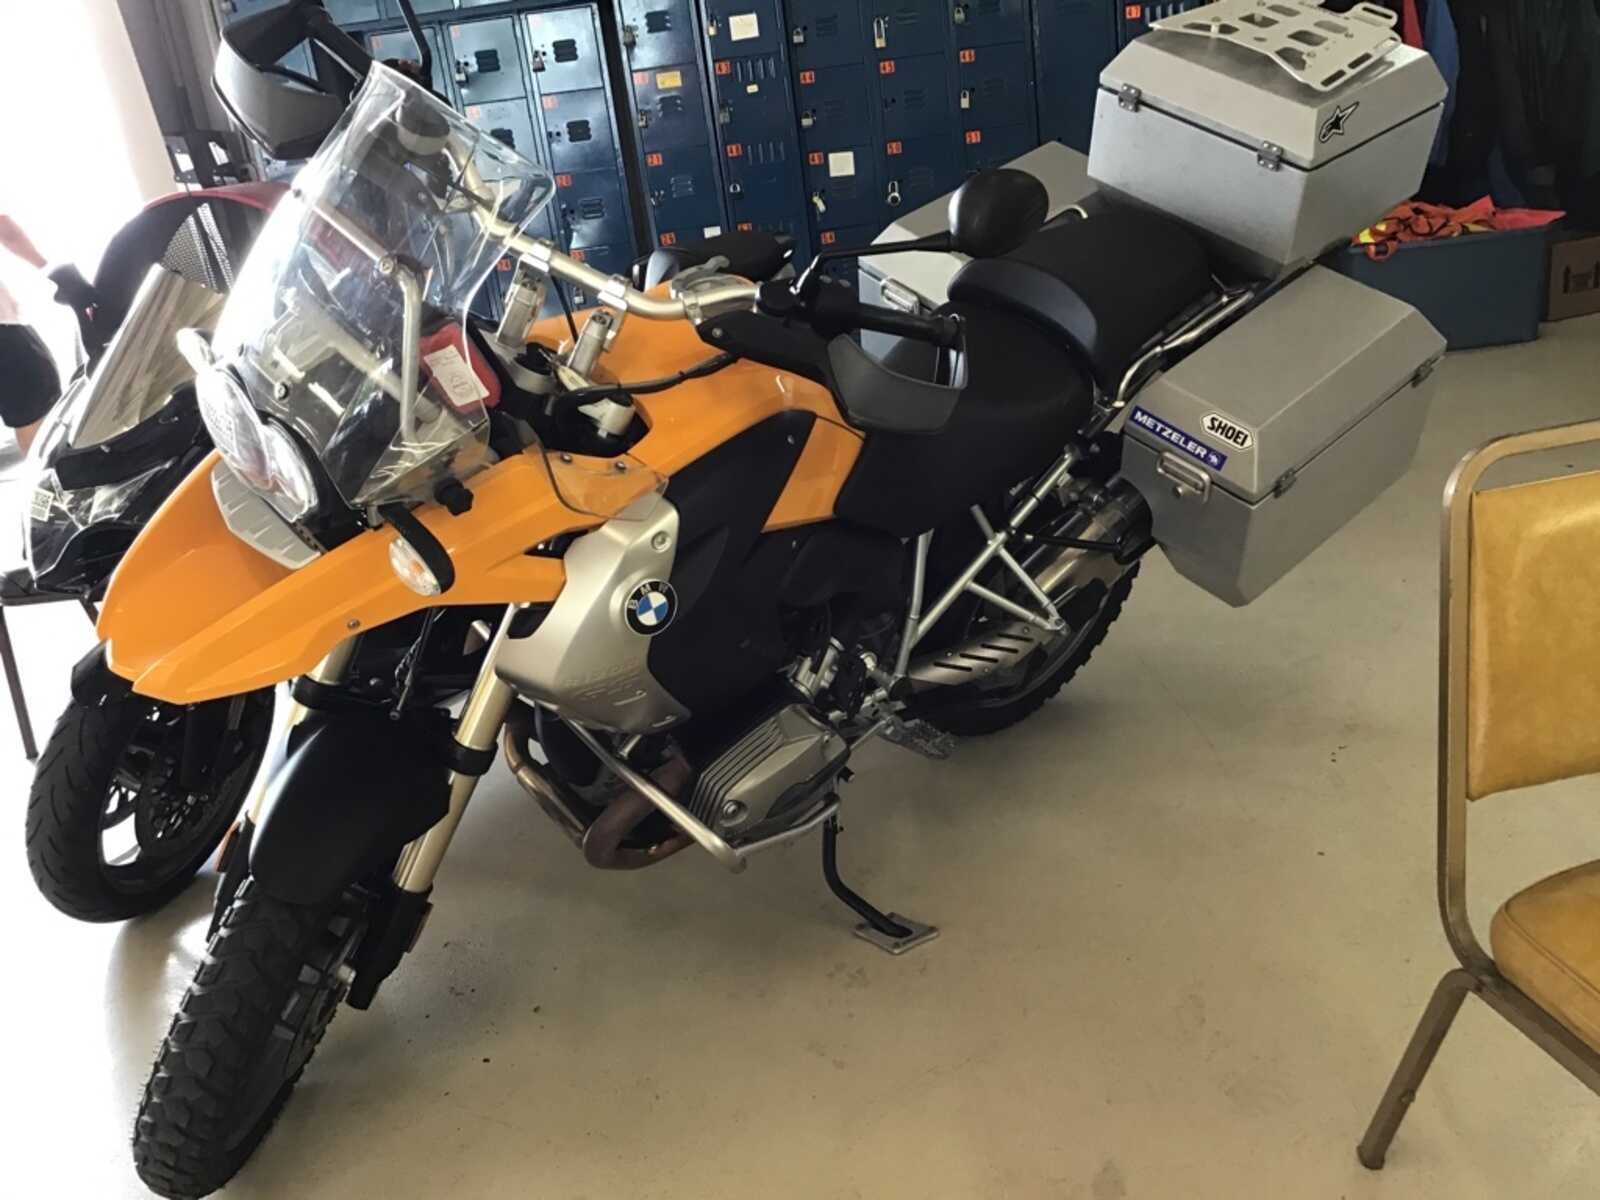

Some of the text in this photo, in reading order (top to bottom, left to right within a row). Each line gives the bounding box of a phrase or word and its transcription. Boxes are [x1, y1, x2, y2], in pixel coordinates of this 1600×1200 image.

[1133, 410, 1207, 459] METZELER
[1207, 416, 1248, 447] SHOEI
[628, 583, 669, 609] BMW
